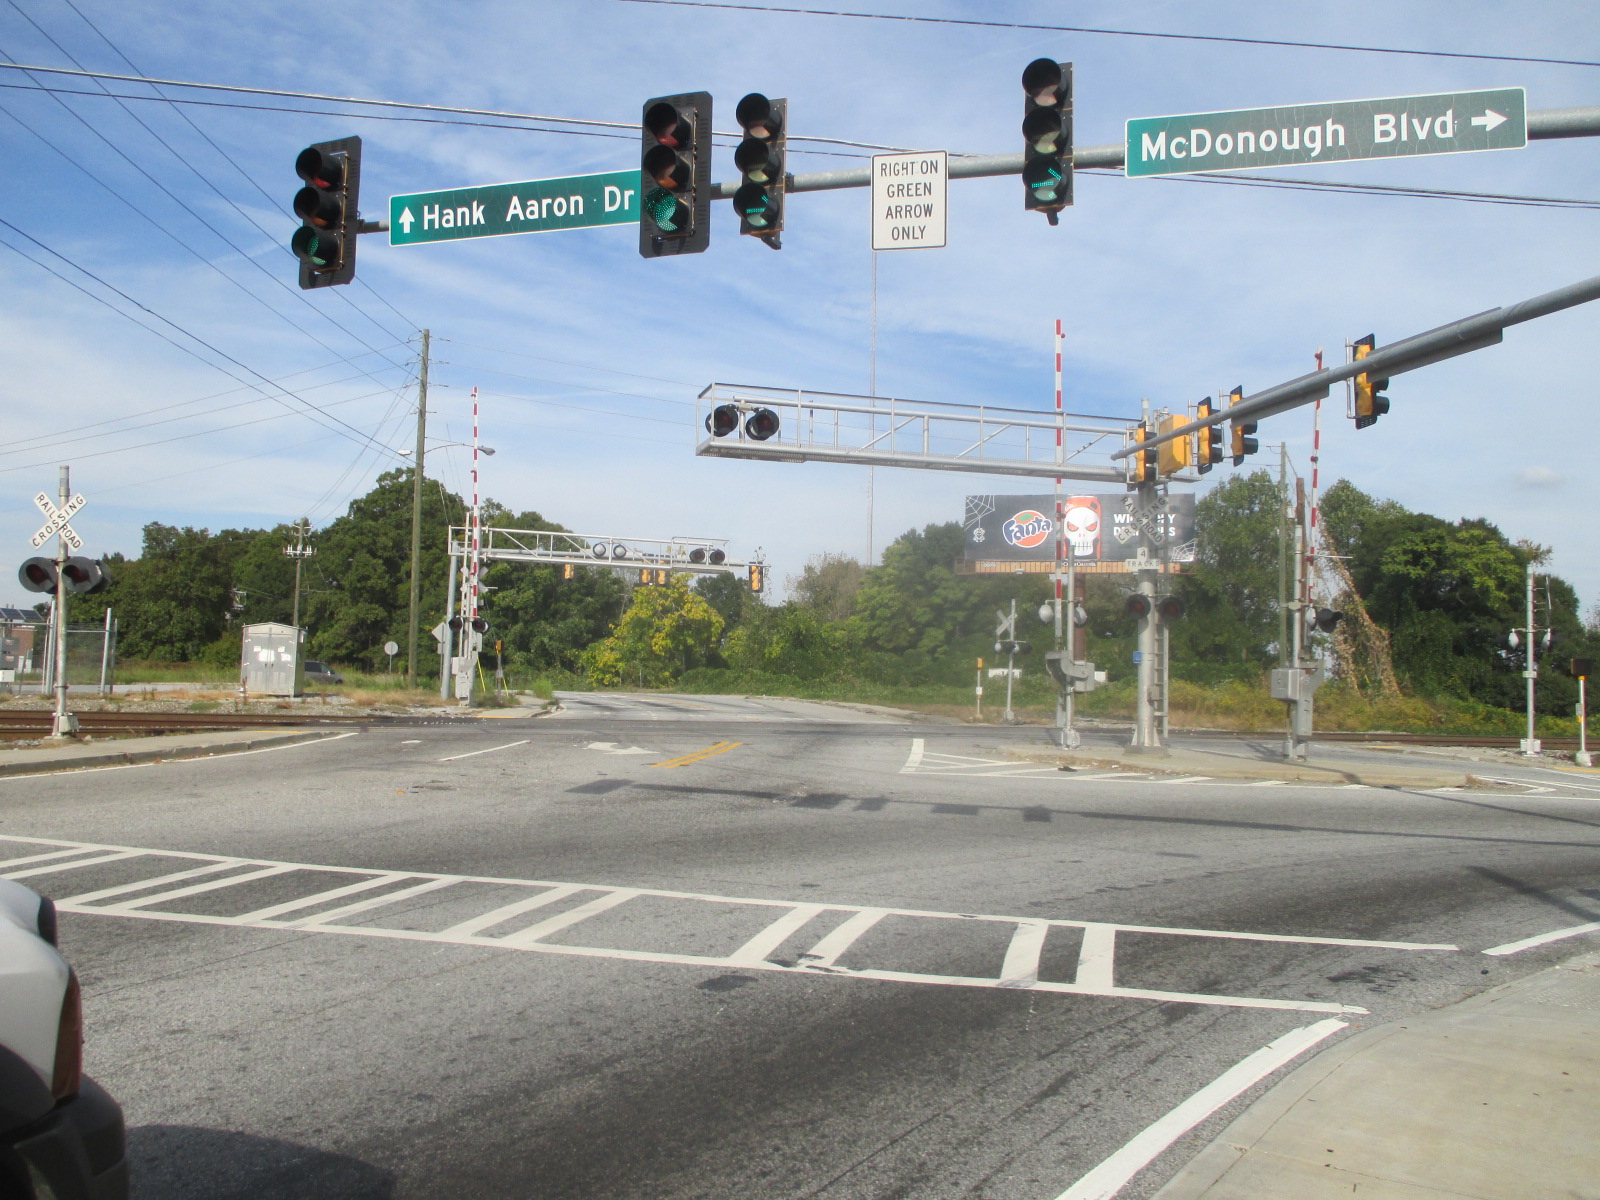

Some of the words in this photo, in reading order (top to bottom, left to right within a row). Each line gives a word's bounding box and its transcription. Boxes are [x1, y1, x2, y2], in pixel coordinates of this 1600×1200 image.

[1141, 117, 1345, 162] McDonough
[1374, 108, 1454, 144] Blvd
[880, 161, 915, 177] RIGHT
[920, 159, 938, 174] ON
[887, 182, 932, 198] GREEN
[423, 200, 486, 230] Hank
[506, 194, 584, 222] Aaron
[604, 185, 635, 213] Dr
[885, 203, 933, 219] ARROW
[891, 225, 926, 241] ONLY
[32, 496, 84, 547] CROSSING
[36, 494, 81, 549] RAILROAD
[1002, 516, 1052, 545] Fanta
[1118, 497, 1166, 541] CROSSING
[1120, 496, 1163, 543] RAILROAD
